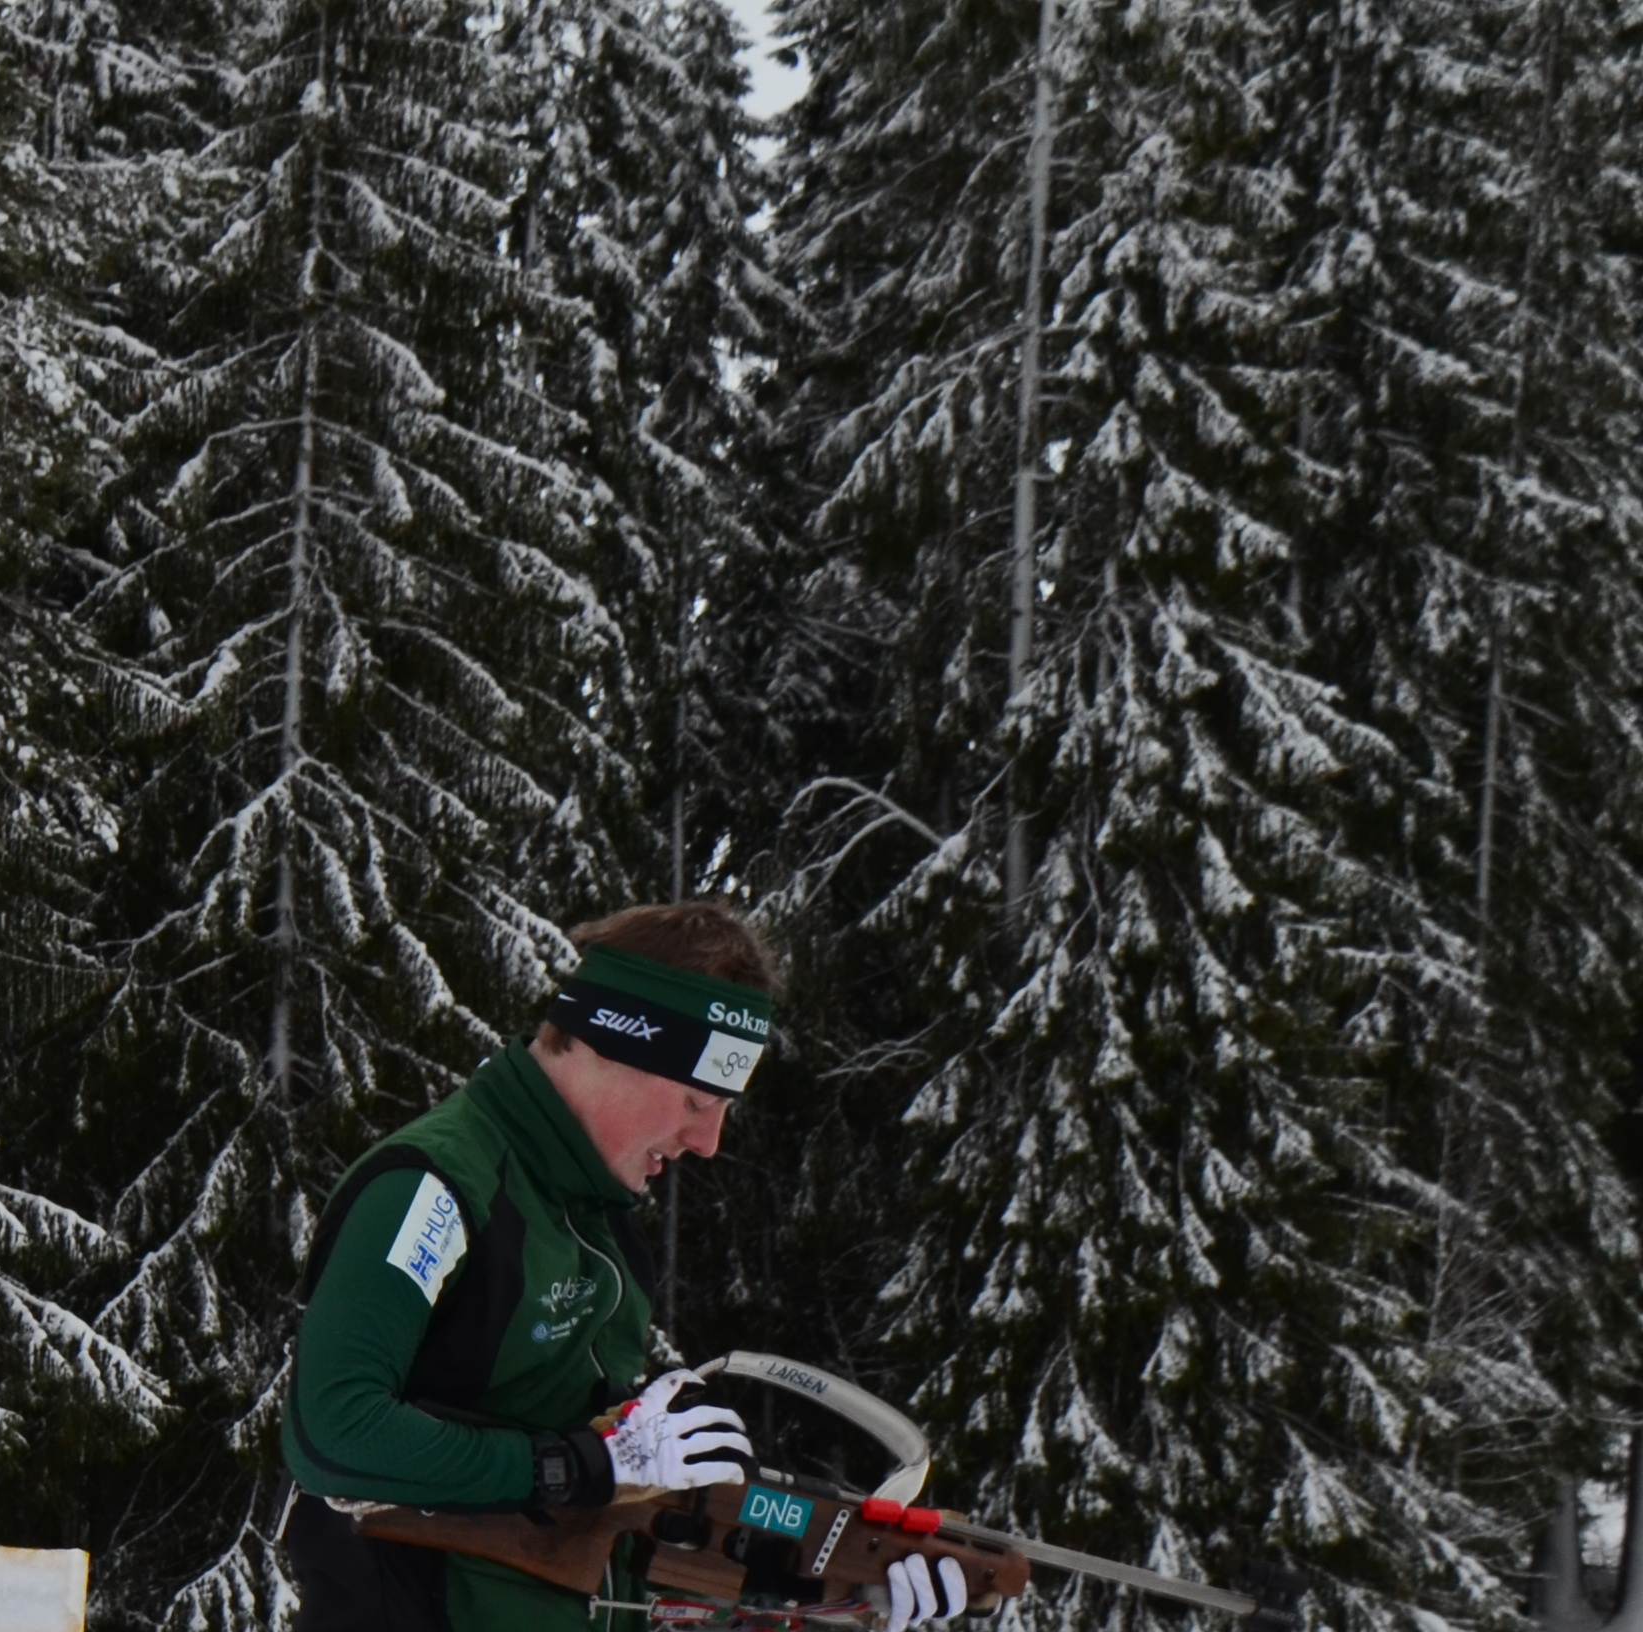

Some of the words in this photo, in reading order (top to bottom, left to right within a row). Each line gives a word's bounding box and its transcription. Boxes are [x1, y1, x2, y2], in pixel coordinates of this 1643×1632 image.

[589, 1008, 663, 1041] swix
[420, 1188, 457, 1245] HUG
[766, 1363, 829, 1394] LARSEN
[749, 1494, 803, 1529] DNB
